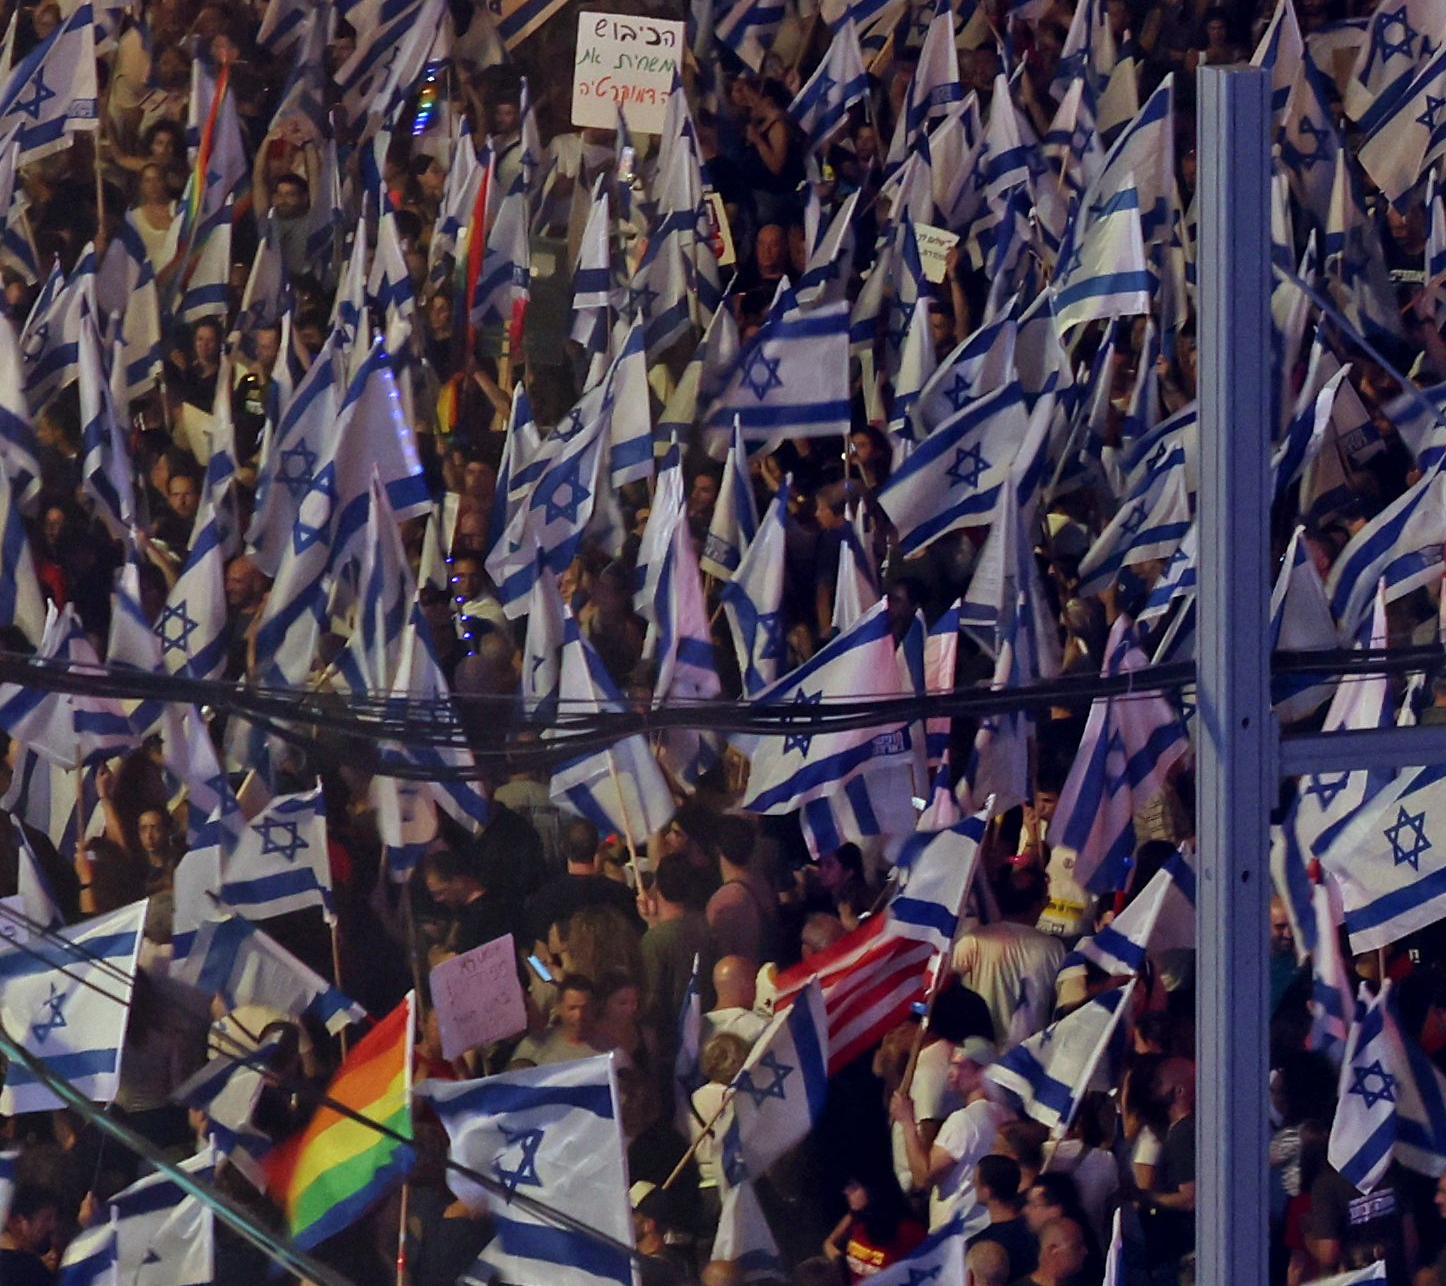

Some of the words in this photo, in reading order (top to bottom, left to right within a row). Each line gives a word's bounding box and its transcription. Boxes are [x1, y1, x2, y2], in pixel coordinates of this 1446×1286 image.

[594, 18, 675, 47] הכיבוש
[577, 49, 601, 66] את
[614, 51, 676, 73] משחית
[579, 76, 670, 105] הדמוקרטיה
